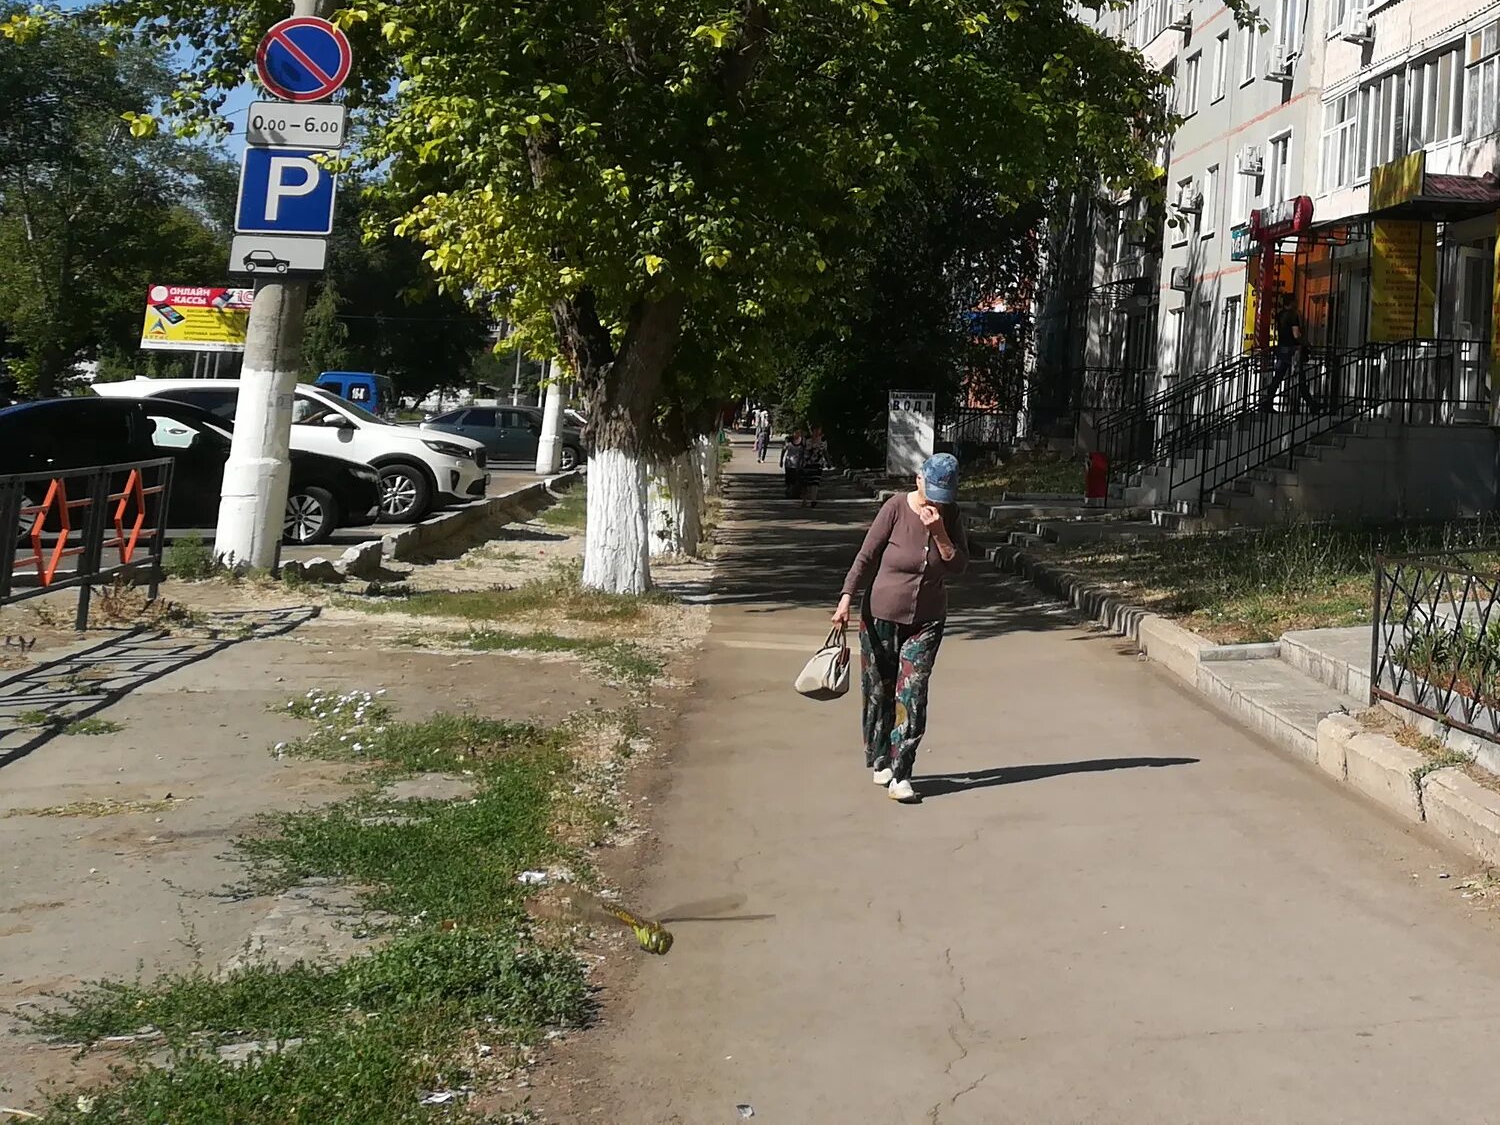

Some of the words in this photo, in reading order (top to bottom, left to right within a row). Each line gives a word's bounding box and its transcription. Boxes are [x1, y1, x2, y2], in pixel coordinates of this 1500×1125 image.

[264, 156, 320, 221] P
[170, 287, 211, 296] ОНЛАЙН
[892, 400, 933, 413] ВОДА
